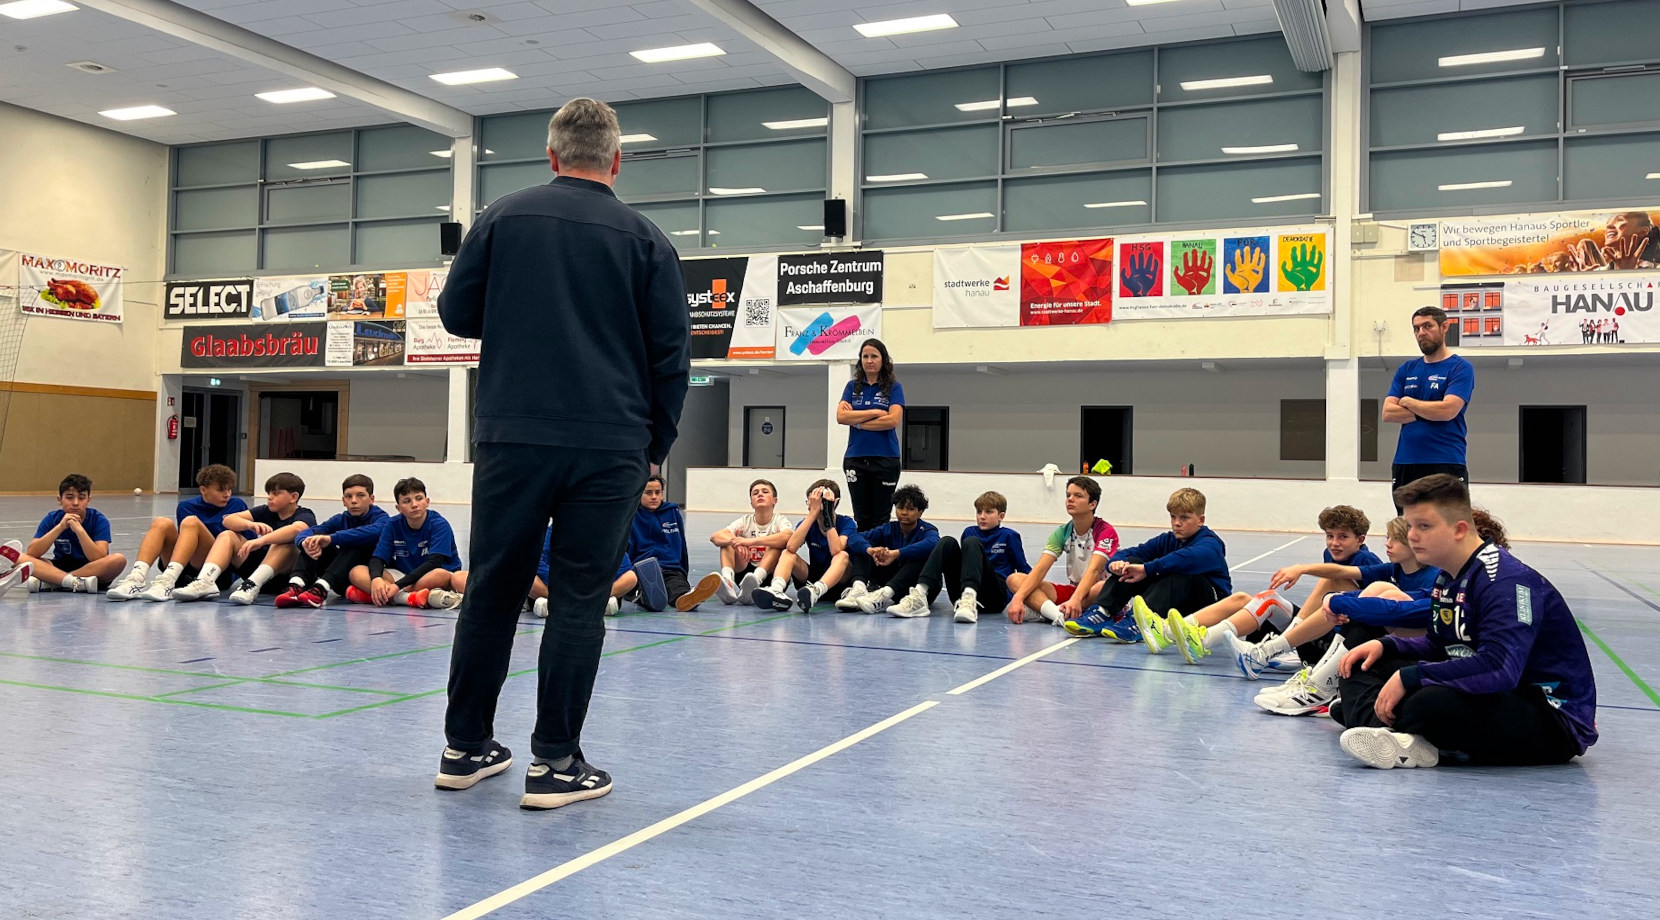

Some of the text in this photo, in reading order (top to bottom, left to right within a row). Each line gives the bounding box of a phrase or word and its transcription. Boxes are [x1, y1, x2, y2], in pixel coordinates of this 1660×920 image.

[1443, 219, 1590, 236] Wir bewegen Hanaus Sportler
[1131, 243, 1152, 252] HSG
[1182, 241, 1203, 249] HANAU
[1443, 237, 1462, 247] und
[22, 254, 121, 279] MAX MORITZ
[780, 259, 882, 276] Porsche Zentrum
[786, 279, 874, 295] Aschaffenburg
[944, 279, 990, 288] stadtwerke
[965, 289, 990, 297] hanau
[169, 284, 250, 315] SELECT
[1551, 291, 1654, 316] HANAU
[1030, 302, 1053, 310] Energie
[784, 325, 809, 337] FRANZ
[190, 331, 319, 358] Glaabsbräu
[1430, 382, 1439, 390] FA
